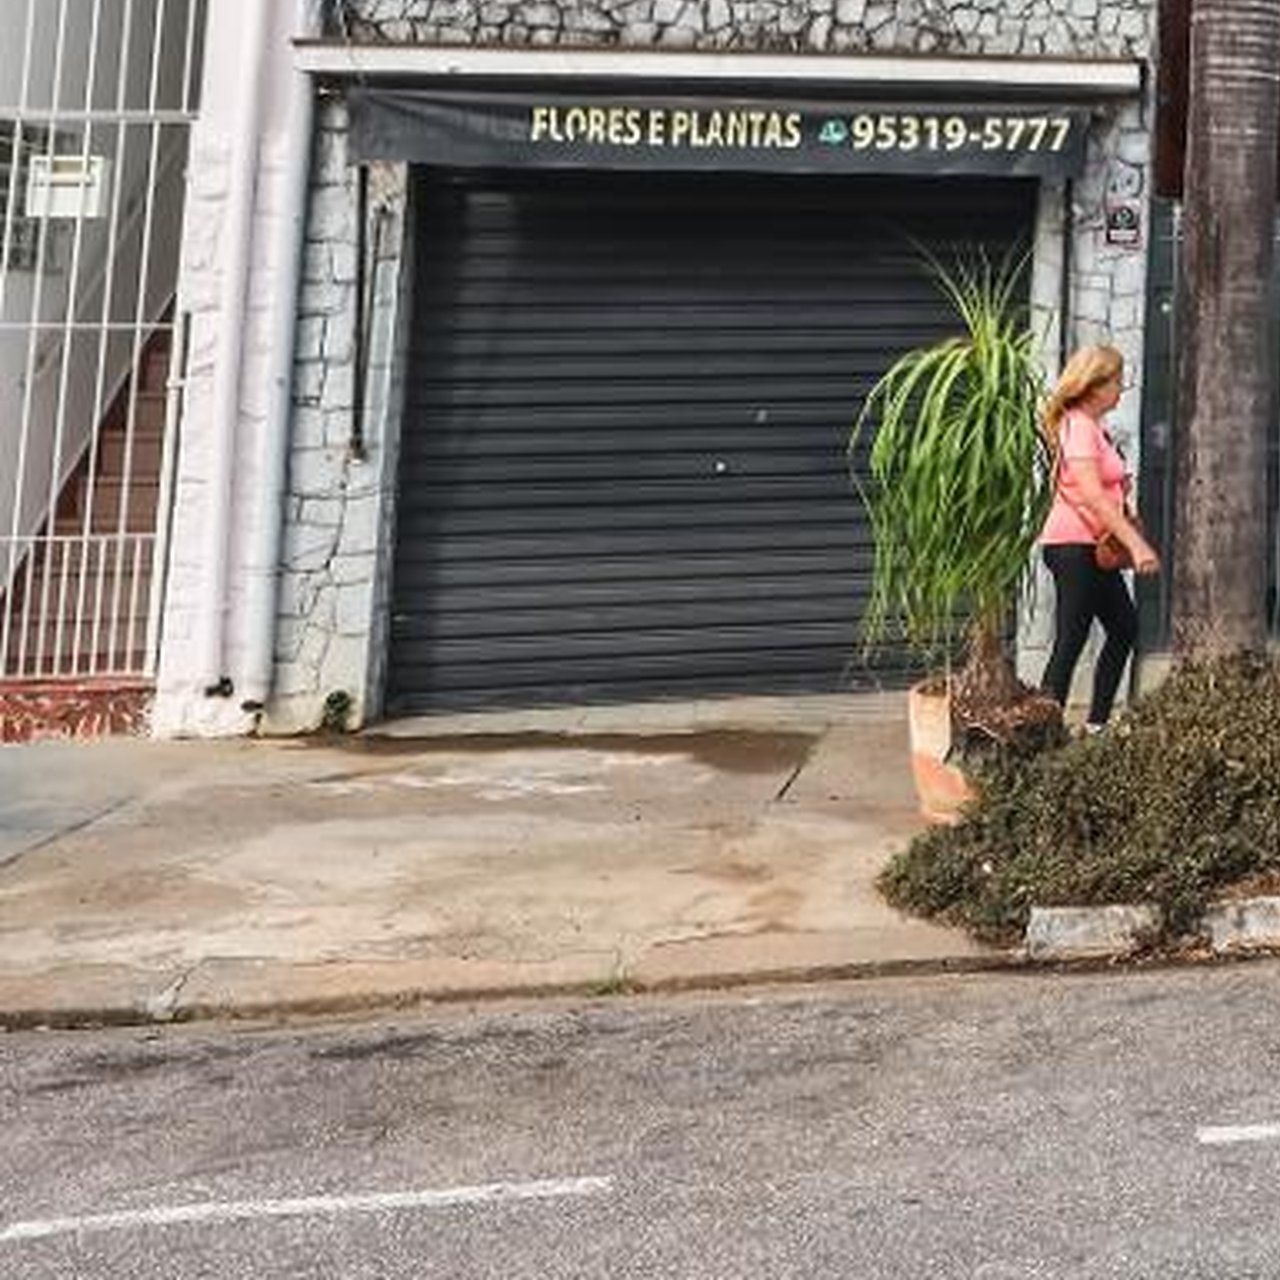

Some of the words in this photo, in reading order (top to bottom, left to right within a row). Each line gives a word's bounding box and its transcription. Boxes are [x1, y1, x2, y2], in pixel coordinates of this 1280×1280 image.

[531, 107, 640, 144] FLORES
[649, 110, 664, 145] E
[671, 110, 801, 148] PLANTAS
[852, 116, 1070, 151] 95319-5777
